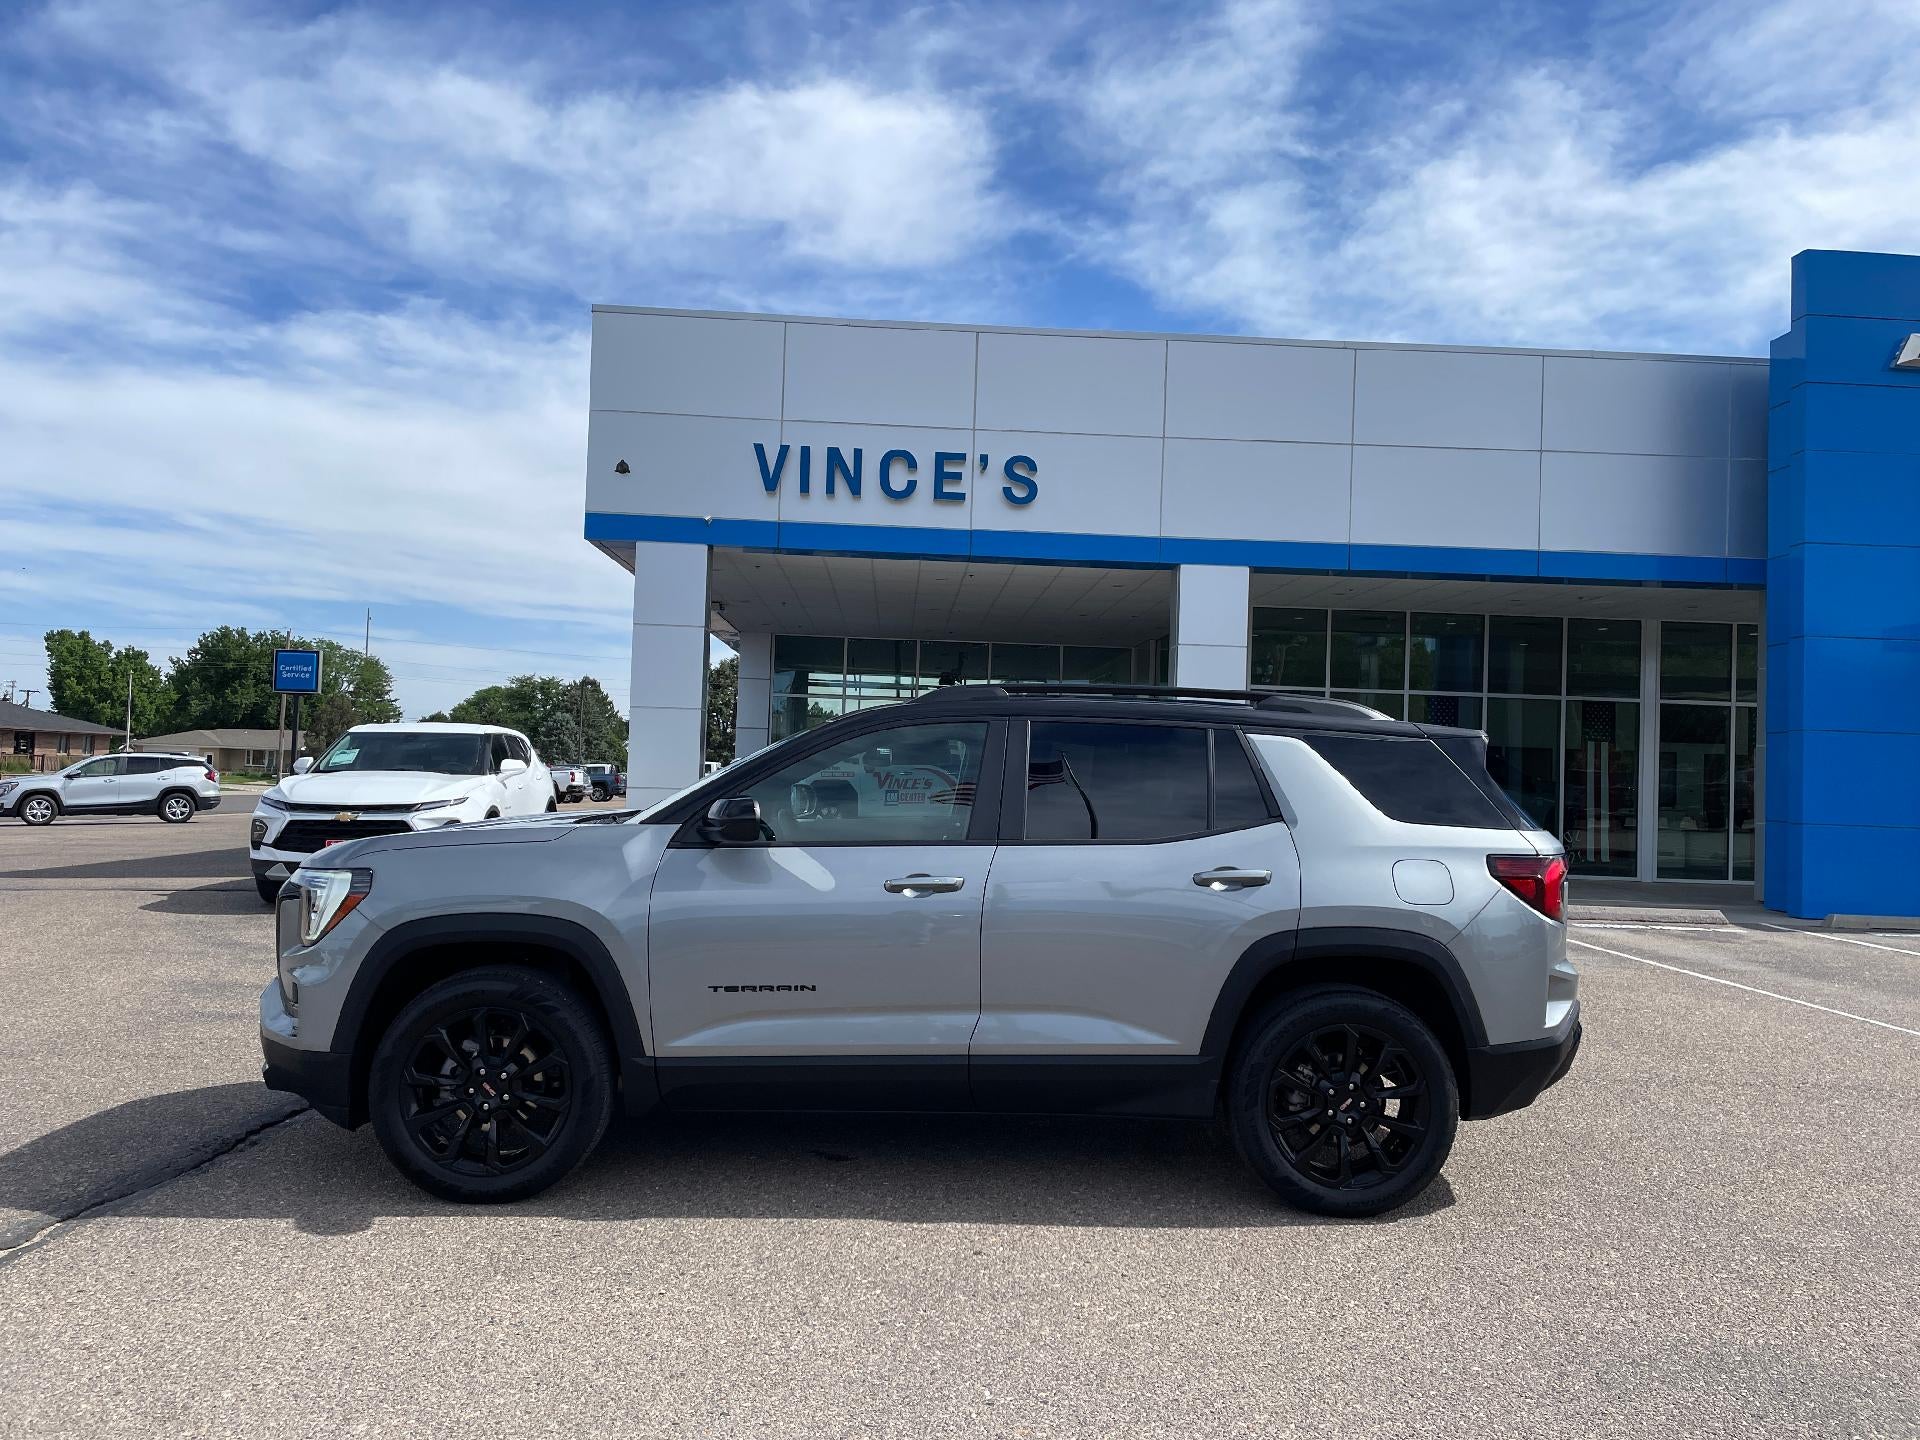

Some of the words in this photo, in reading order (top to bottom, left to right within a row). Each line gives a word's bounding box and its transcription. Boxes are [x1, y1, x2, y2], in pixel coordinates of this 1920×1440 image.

[753, 442, 1039, 506] VINCE'S
[280, 664, 313, 672] Certified
[281, 671, 311, 679] Service
[707, 984, 817, 993] TERRAIN
